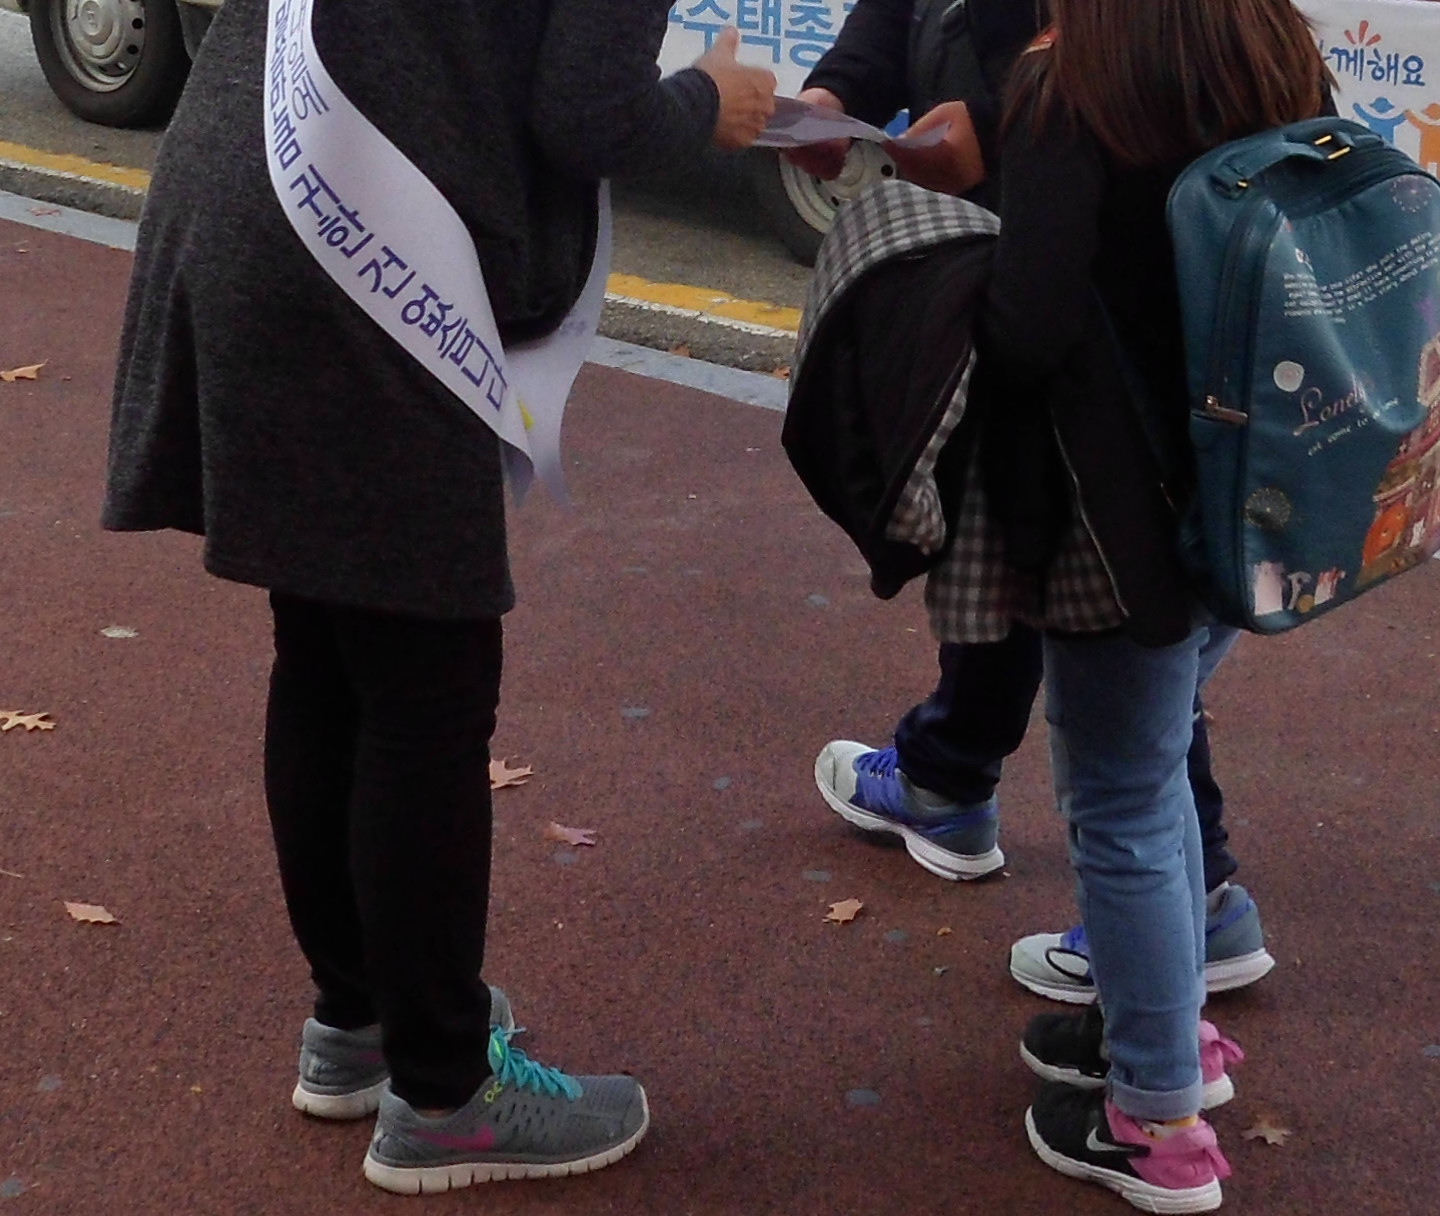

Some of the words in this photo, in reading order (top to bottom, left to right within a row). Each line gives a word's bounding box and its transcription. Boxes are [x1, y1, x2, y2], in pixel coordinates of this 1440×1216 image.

[1321, 40, 1426, 86] 께해요
[290, 164, 374, 259] 귀한
[357, 245, 417, 299] 건
[400, 284, 509, 412] 없습니다
